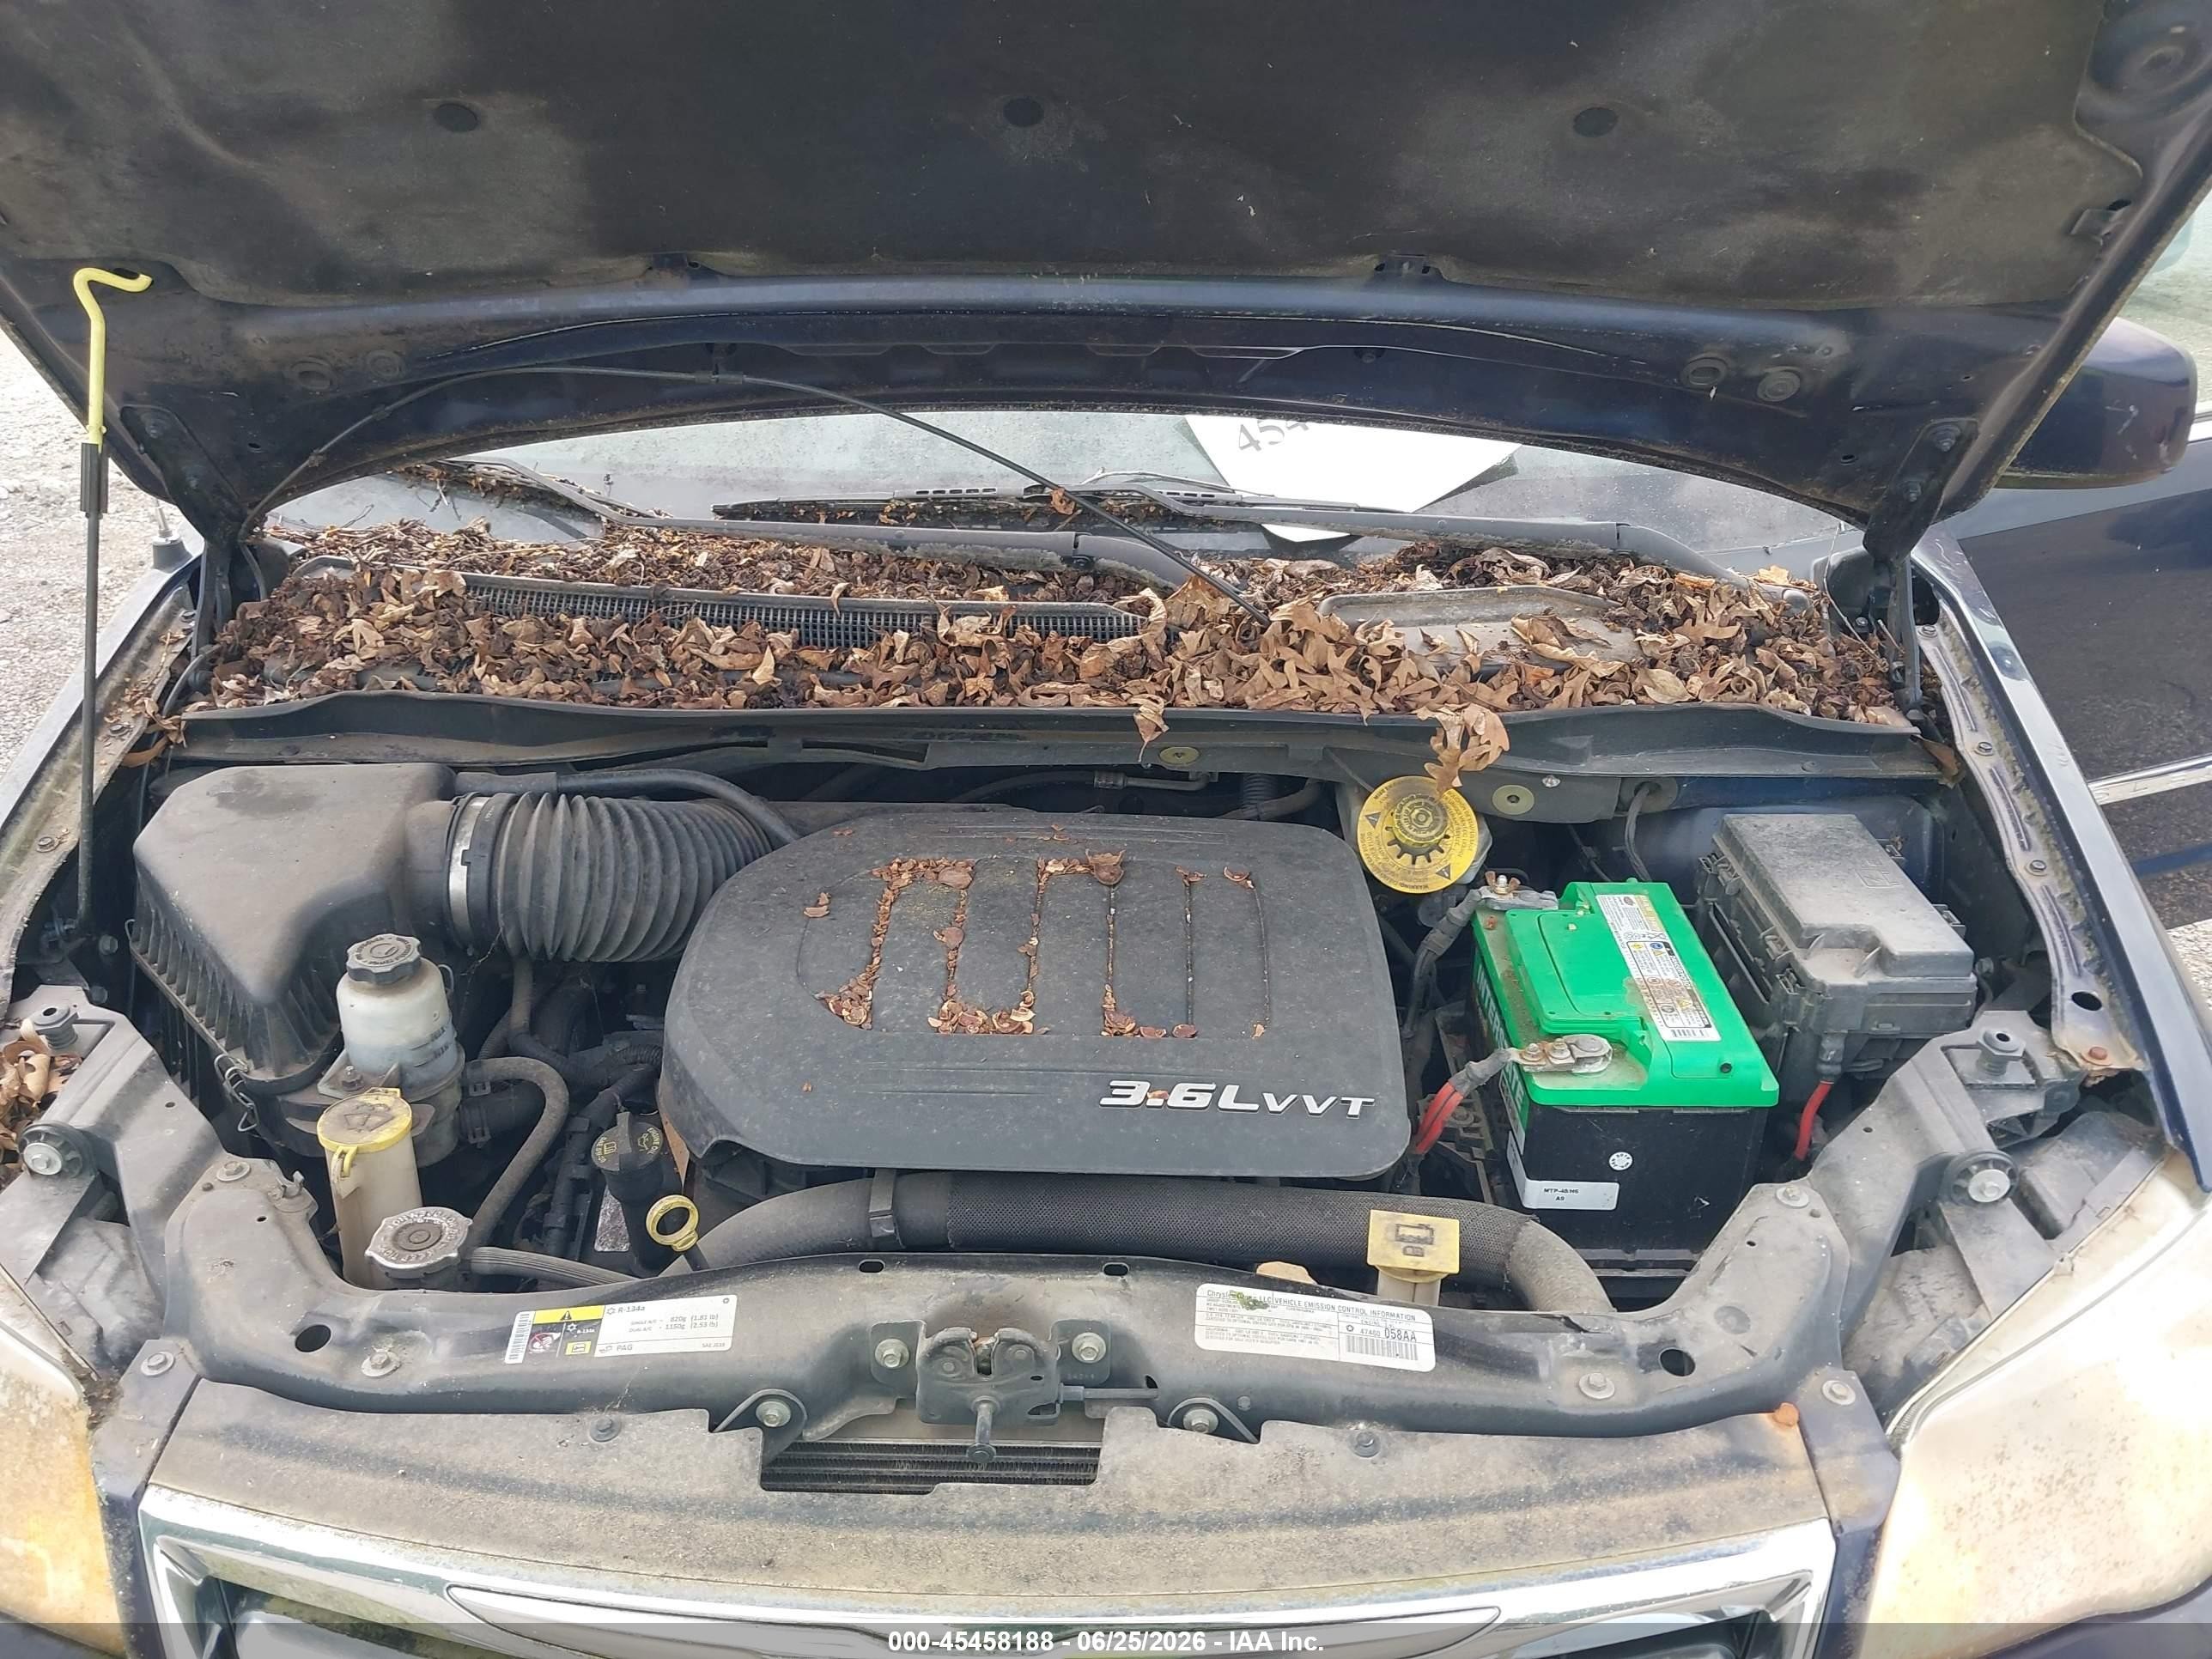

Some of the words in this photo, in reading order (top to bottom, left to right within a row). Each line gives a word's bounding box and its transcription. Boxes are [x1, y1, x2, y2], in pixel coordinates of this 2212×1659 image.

[1476, 962, 1526, 1111] INTERSATE
[647, 1127, 660, 1145] ENGINE
[646, 1146, 659, 1155] OIL
[1274, 1297, 1303, 1307] VEHICLE
[1304, 1301, 1335, 1311] EMISSION
[1338, 1305, 1368, 1316] CONTROL
[1370, 1310, 1416, 1322] INFORMATION
